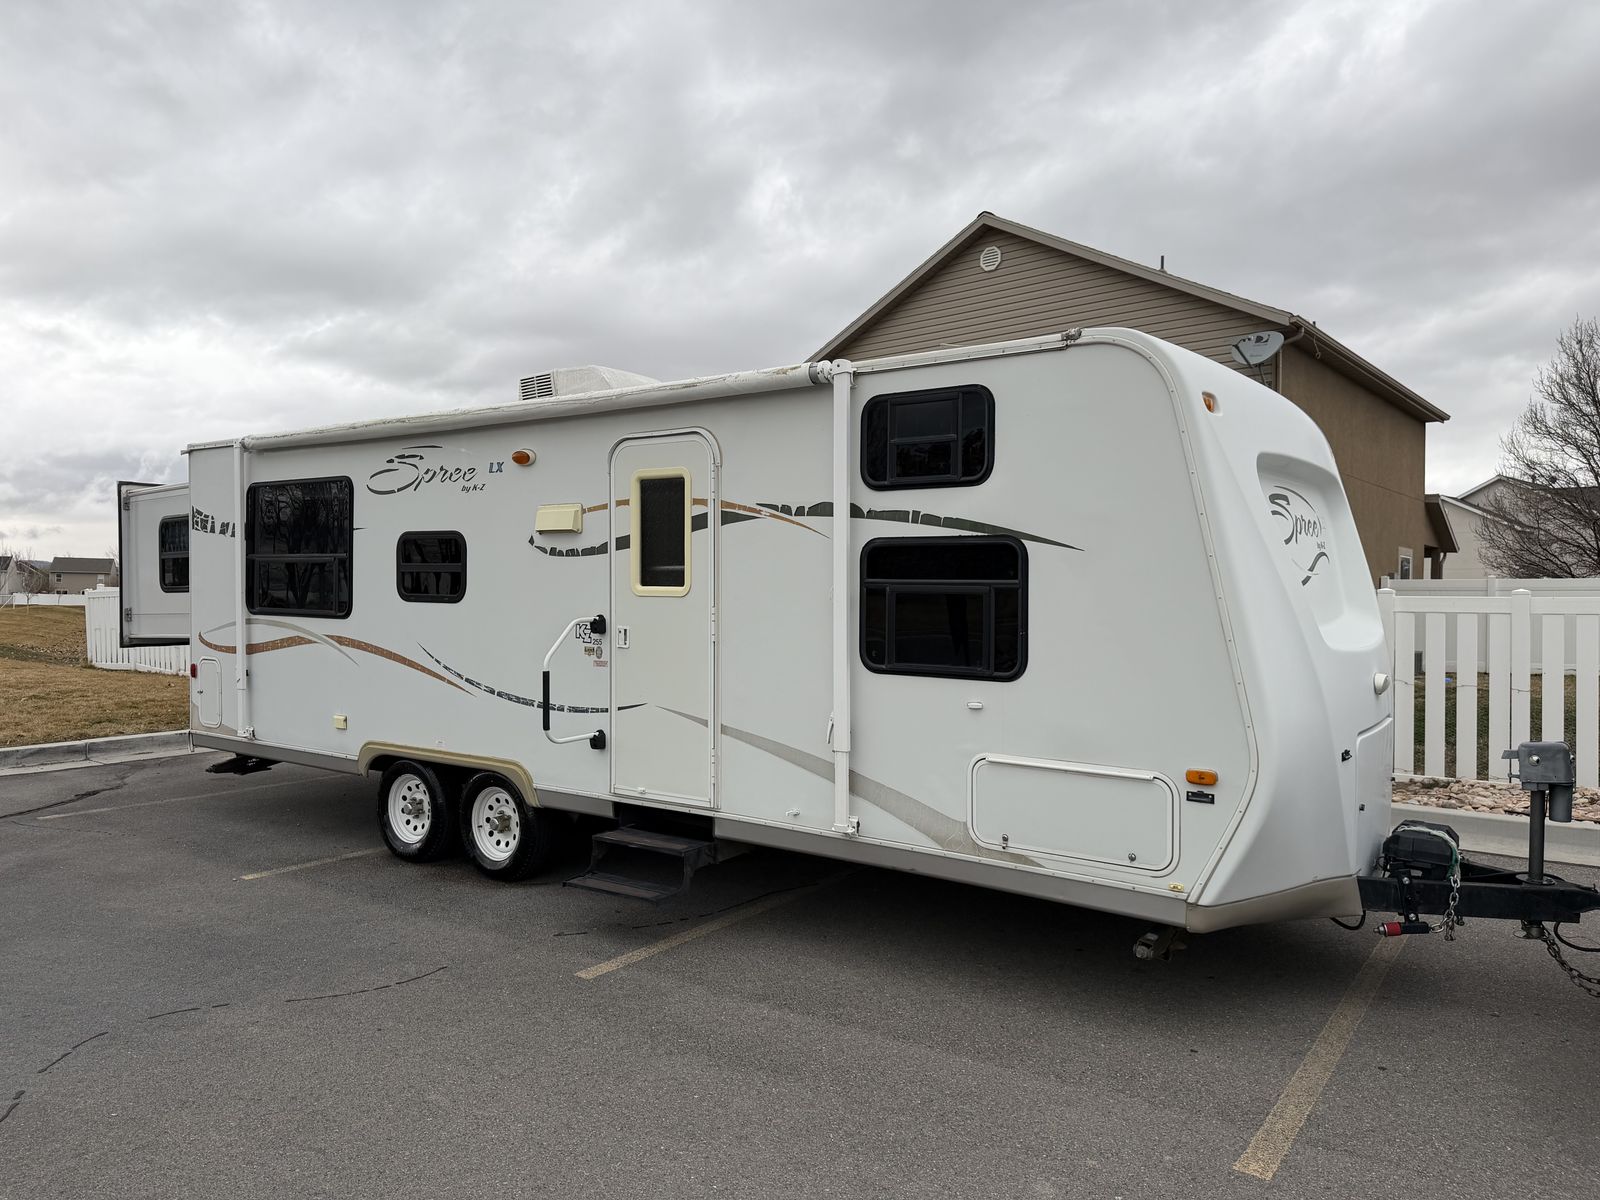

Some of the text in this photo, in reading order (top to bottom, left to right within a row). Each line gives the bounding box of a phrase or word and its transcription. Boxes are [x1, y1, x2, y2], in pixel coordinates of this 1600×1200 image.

[367, 453, 478, 495] Spree
[488, 461, 505, 474] LX
[461, 483, 486, 494] by K-Z
[1268, 493, 1320, 545] Spree
